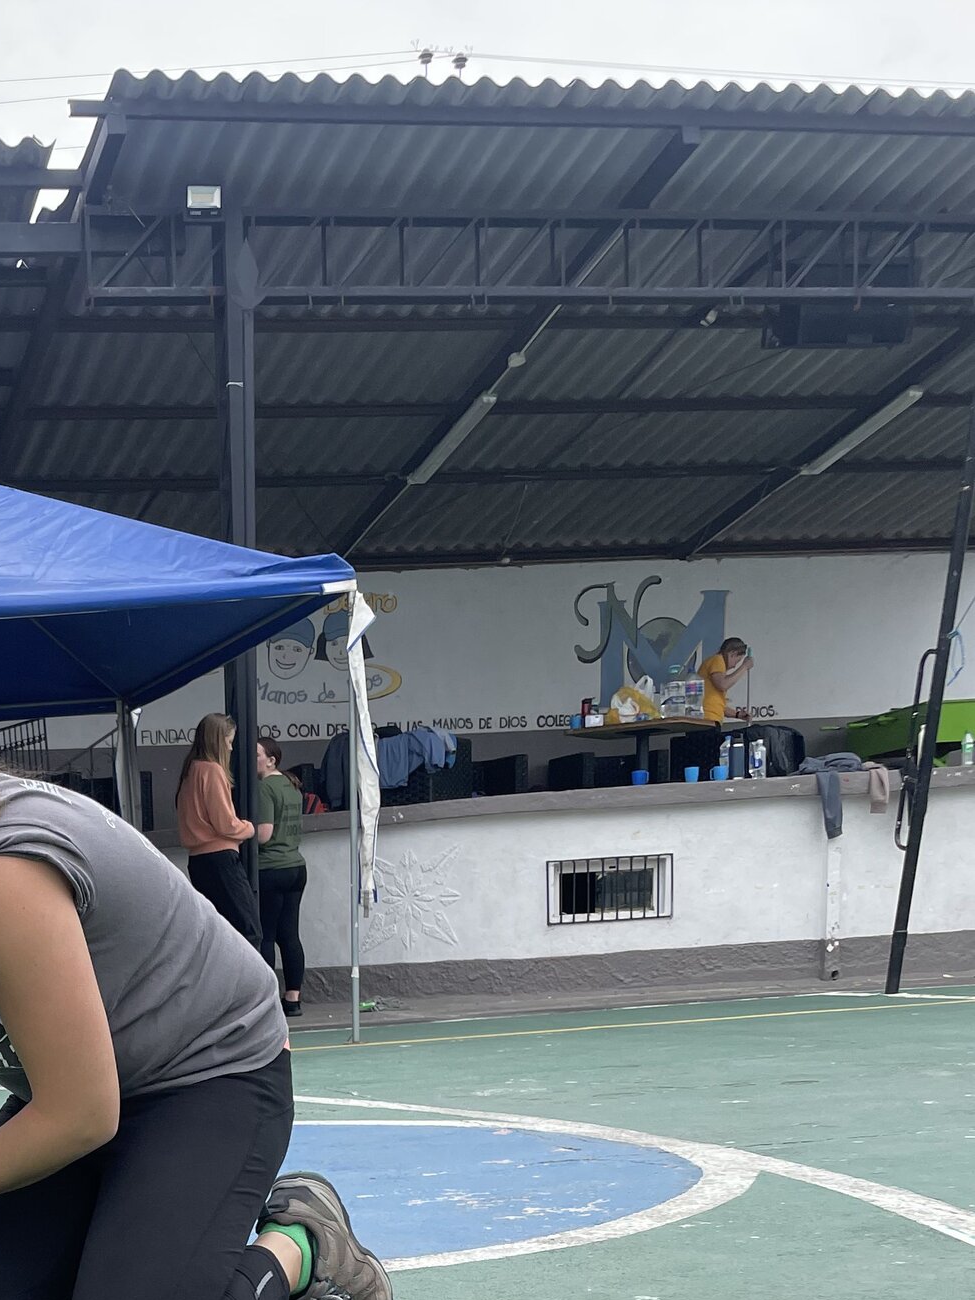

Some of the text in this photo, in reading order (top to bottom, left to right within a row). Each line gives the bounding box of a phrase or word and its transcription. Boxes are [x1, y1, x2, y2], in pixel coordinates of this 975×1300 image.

[257, 678, 308, 704] Manos
[318, 682, 335, 702] de
[141, 728, 197, 745] FUNDAC
[287, 723, 320, 737] CON
[432, 717, 473, 730] MANOS
[479, 717, 492, 730] DE
[499, 715, 527, 729] DIOS
